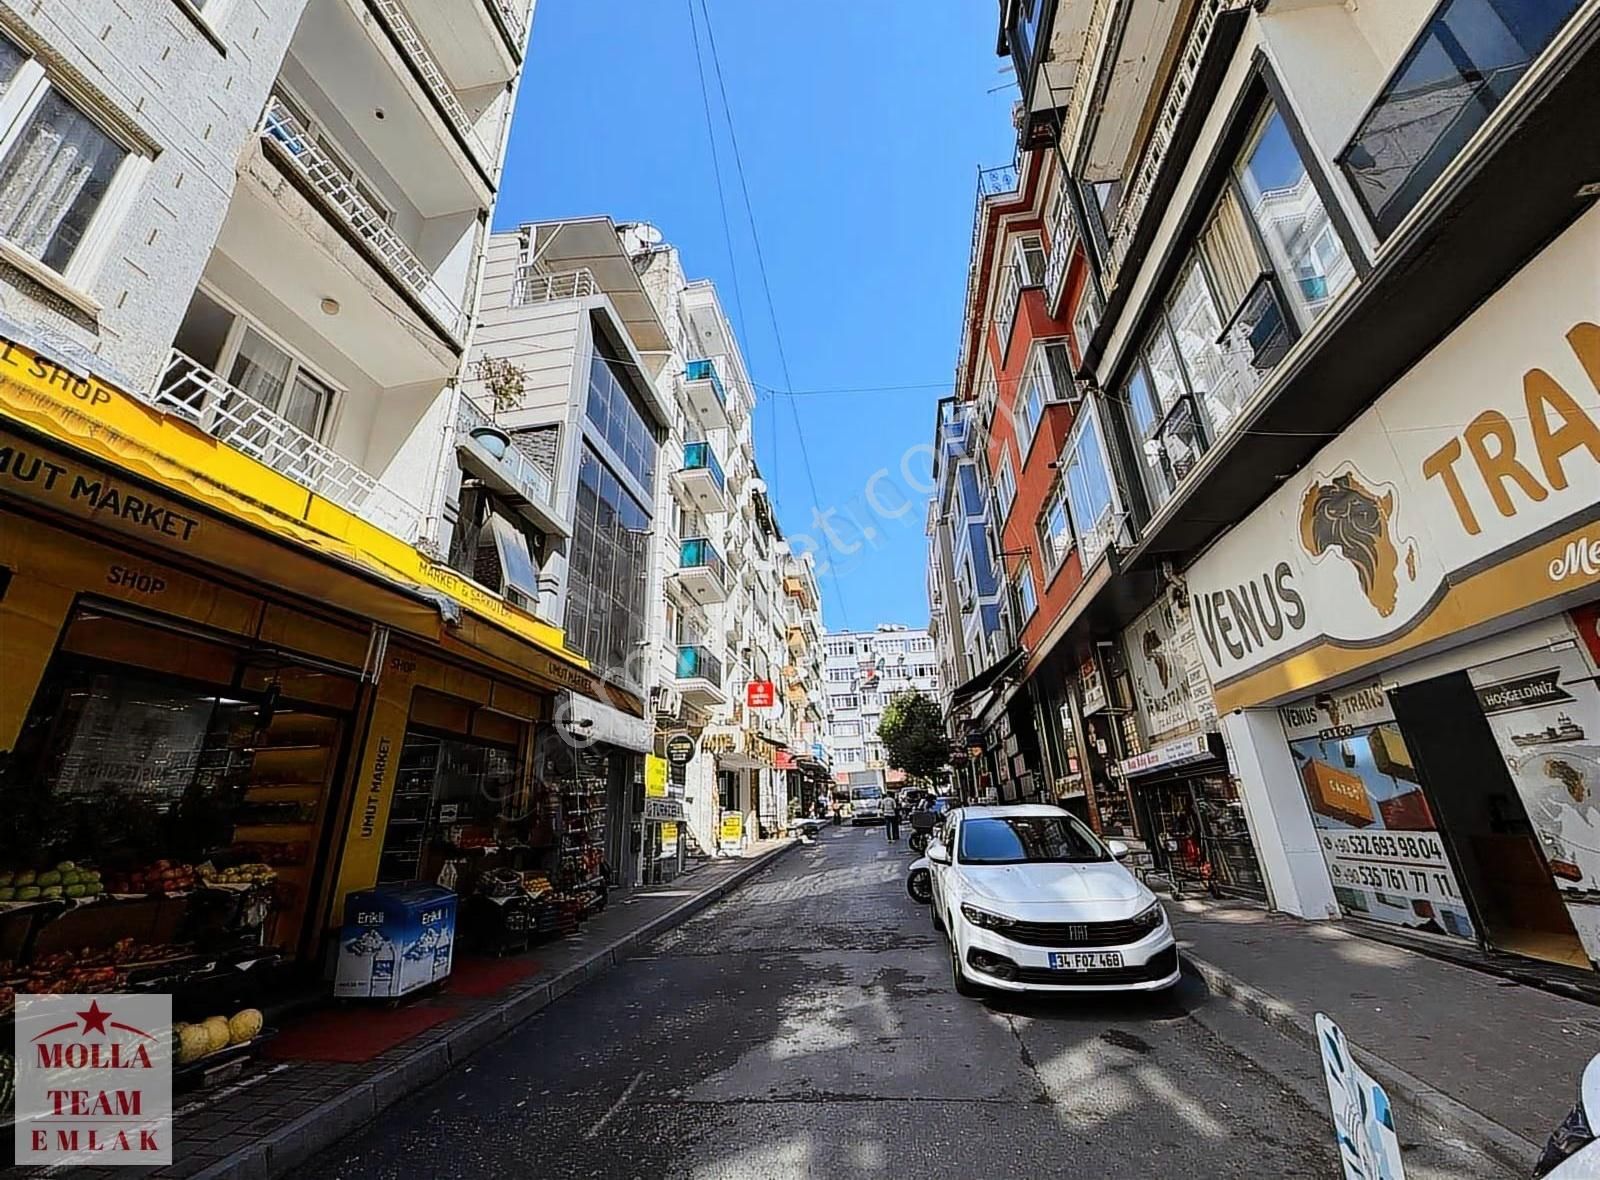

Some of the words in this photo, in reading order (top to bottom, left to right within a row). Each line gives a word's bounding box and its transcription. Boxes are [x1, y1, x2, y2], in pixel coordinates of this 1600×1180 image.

[28, 356, 112, 406] SHOP
[70, 476, 199, 541] MARKET
[106, 566, 166, 595] SHOP
[419, 561, 458, 592] MARKET
[1193, 561, 1306, 669] VENUS
[390, 657, 417, 674] SHOP
[1281, 706, 1319, 729] VENUS
[1342, 682, 1385, 714] TRANS
[1484, 680, 1557, 707] HOŞGELDİNİZ
[361, 796, 378, 839] UMUT
[371, 736, 391, 794] MARKET
[1349, 835, 1372, 855] 532
[1372, 836, 1398, 856] 693
[1359, 866, 1382, 887] 535
[1381, 867, 1408, 891] 761
[1068, 925, 1089, 941] FIAT
[1057, 955, 1071, 968] 34
[1075, 954, 1096, 968] FOZ
[1100, 953, 1120, 967] 468
